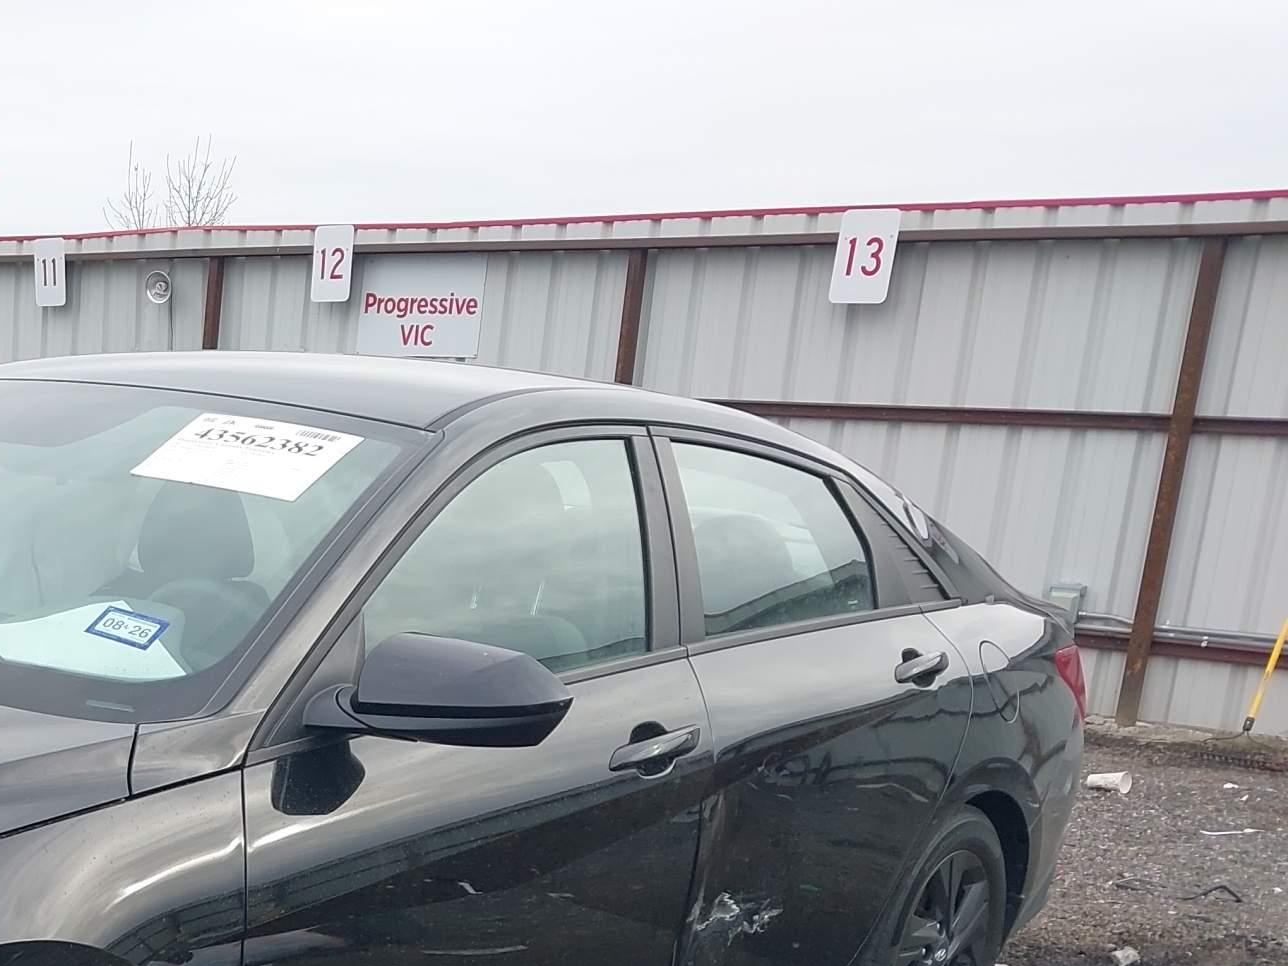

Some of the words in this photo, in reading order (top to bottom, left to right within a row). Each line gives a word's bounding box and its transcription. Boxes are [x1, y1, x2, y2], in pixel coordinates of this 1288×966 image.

[319, 247, 345, 280] 12
[845, 236, 884, 276] 13
[41, 258, 57, 286] 11
[364, 292, 478, 318] Progressive
[400, 324, 434, 346] VIC
[194, 428, 324, 456] 43562382
[103, 618, 125, 631] 08
[128, 625, 152, 639] 26
